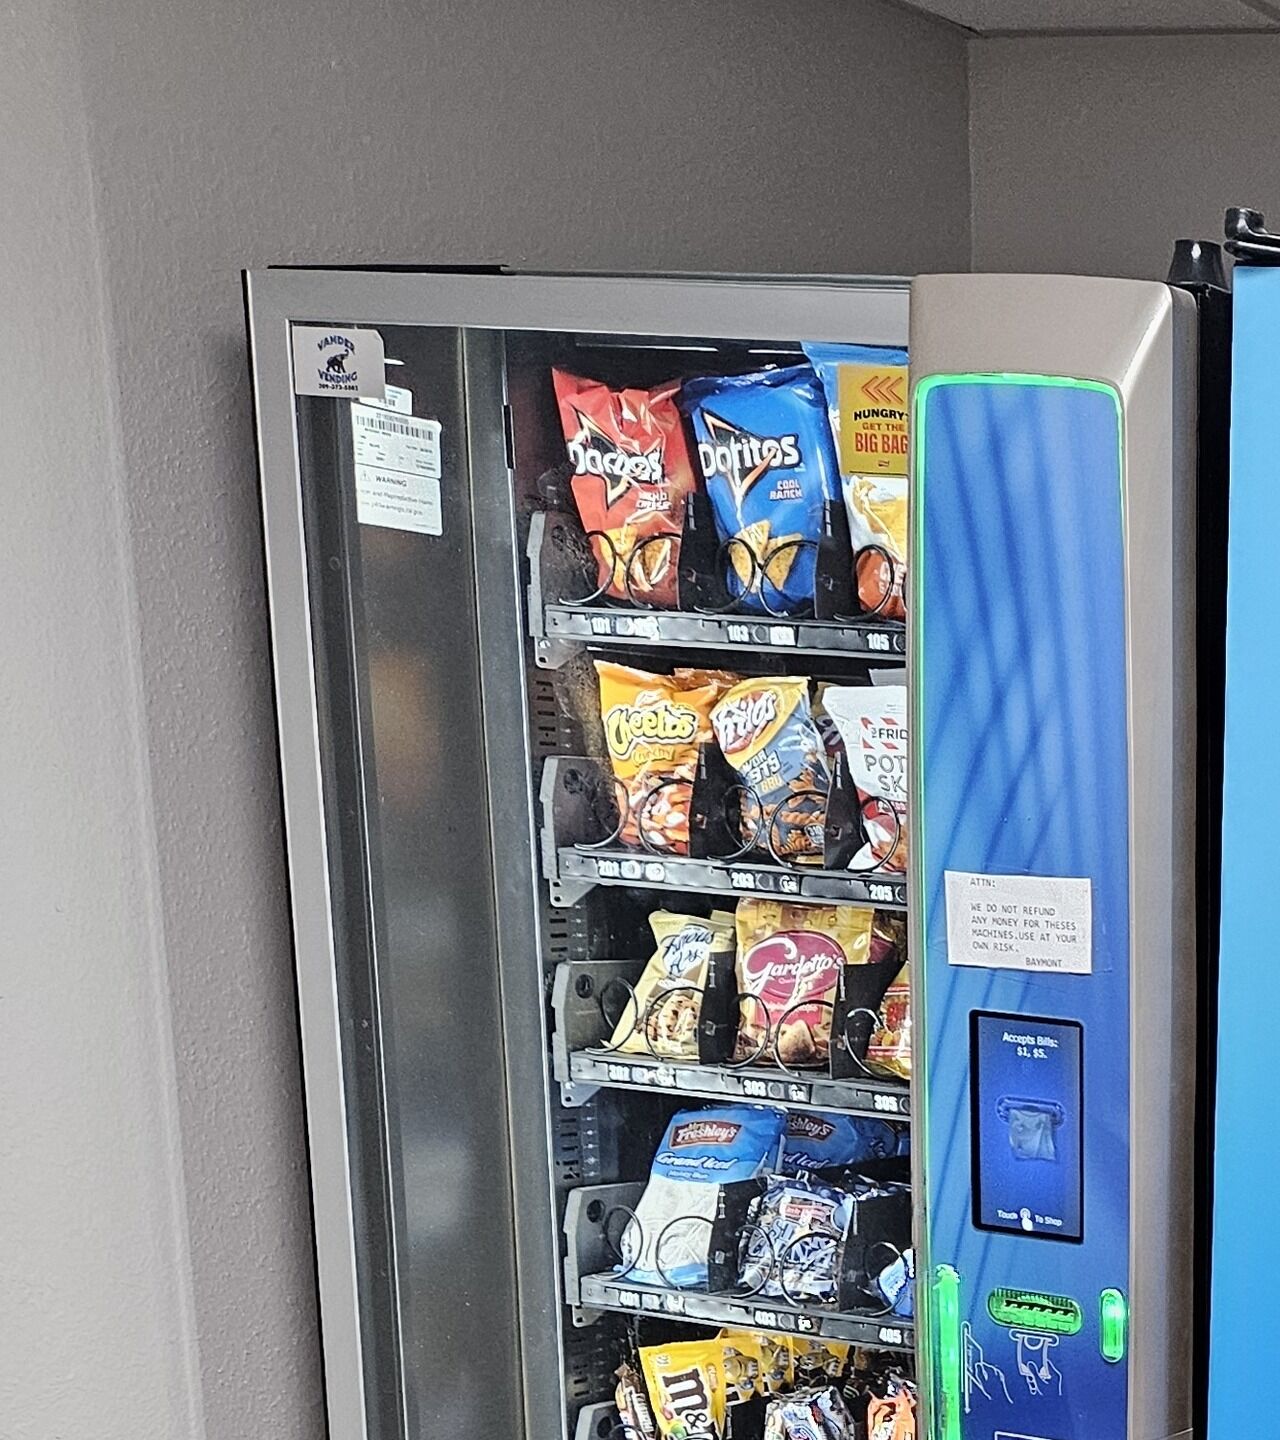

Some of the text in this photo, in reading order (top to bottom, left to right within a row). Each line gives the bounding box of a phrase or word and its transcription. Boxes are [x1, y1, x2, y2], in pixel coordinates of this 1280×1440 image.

[317, 334, 356, 355] VANDER
[317, 368, 358, 384] VENDING
[862, 422, 905, 432] GET THE
[855, 432, 908, 454] BIG BAG
[698, 434, 801, 478] Doritos
[375, 475, 407, 487] WARNING
[769, 488, 804, 500] RANCH
[728, 626, 749, 641] 103
[867, 633, 889, 649] 105
[713, 690, 778, 747] Fritos
[606, 704, 698, 757] Cheetos
[970, 877, 996, 888] ATTN:
[870, 884, 892, 901] 205
[970, 903, 1056, 917] WE DO NOT REFUND
[971, 916, 1077, 931] ANY MONEY FOR THESES
[1040, 933, 1051, 942] AT
[1055, 934, 1077, 944] YOUR
[972, 941, 1019, 953] OWN RISK.
[744, 936, 845, 996] Gardetto's
[1025, 957, 1062, 968] BAYMONT
[1002, 1031, 1059, 1048] Accepts Bills:
[677, 1122, 738, 1143] Freshley's
[997, 1208, 1018, 1221] Touch
[1045, 1215, 1063, 1229] Shop
